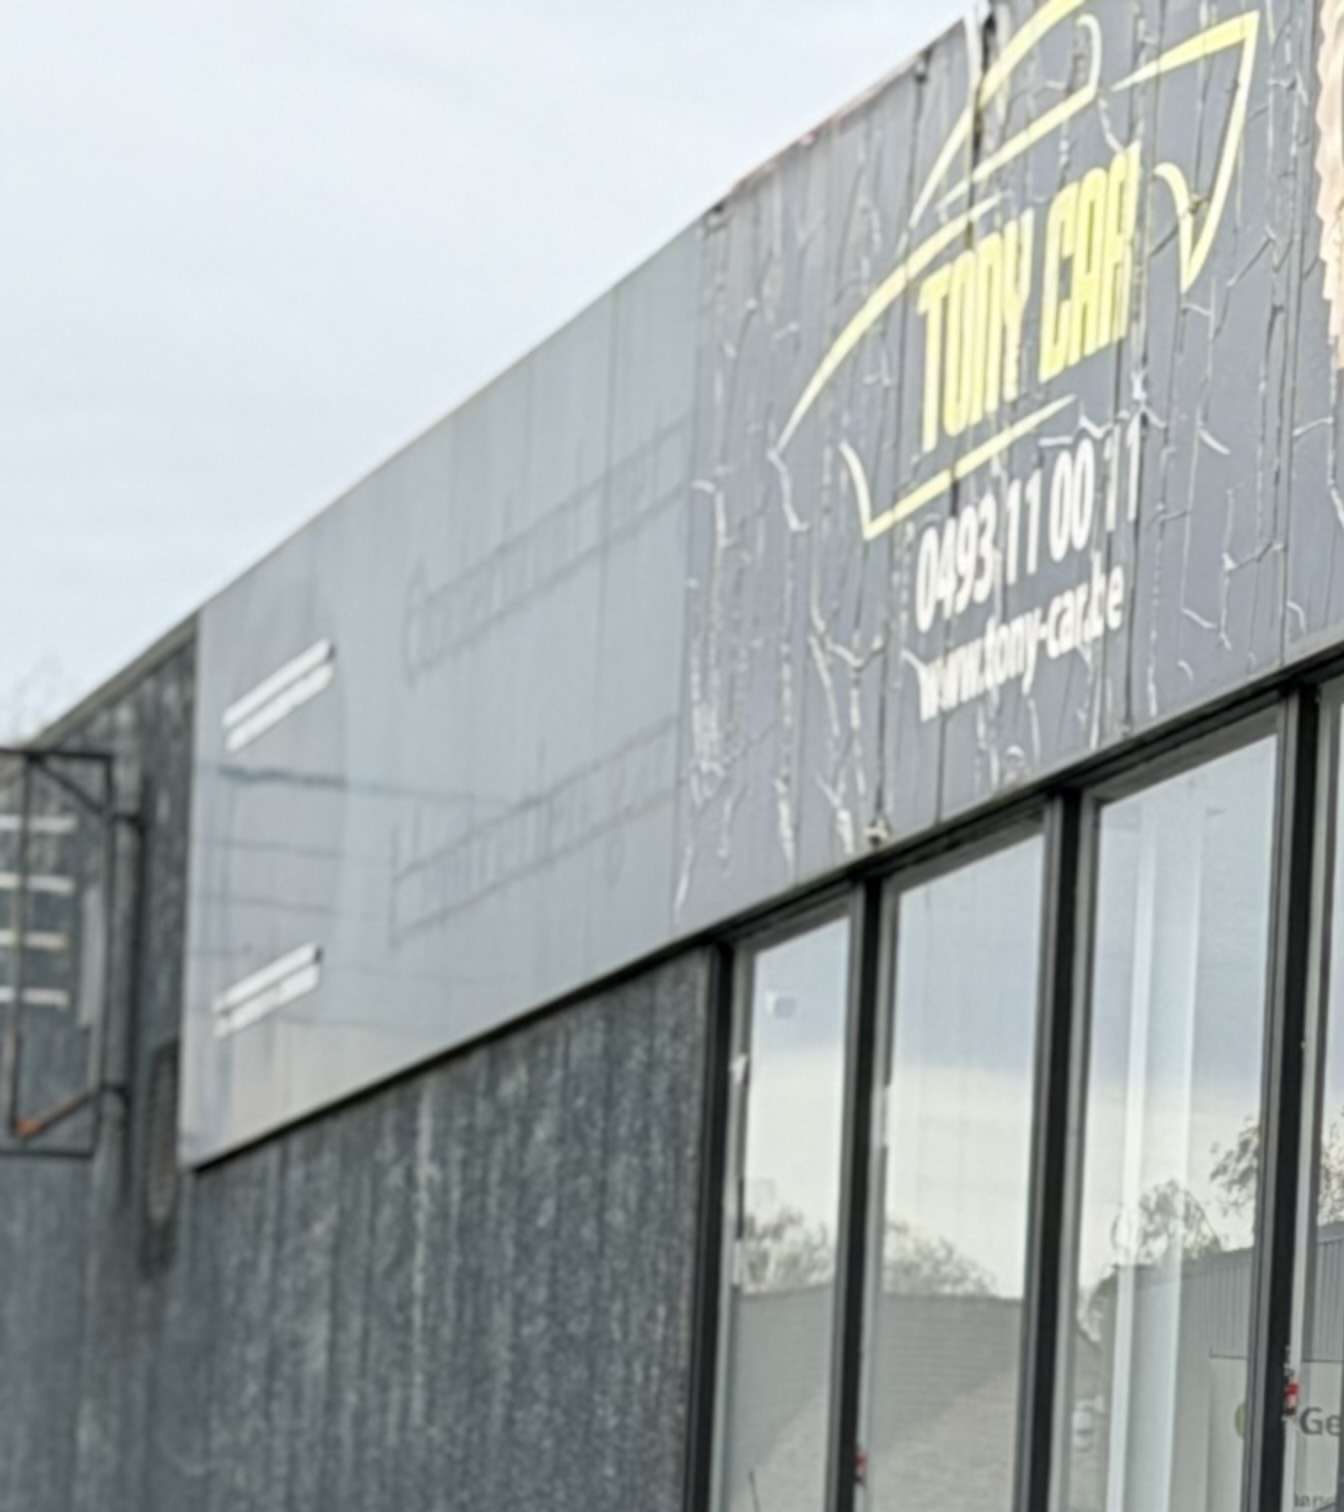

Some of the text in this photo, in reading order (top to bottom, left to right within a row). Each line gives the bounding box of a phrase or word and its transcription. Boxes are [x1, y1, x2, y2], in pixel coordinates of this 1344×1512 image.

[917, 140, 1142, 454] TONY CAR
[916, 490, 996, 633] 0493
[1006, 468, 1042, 586] 11
[1050, 437, 1096, 562] 00
